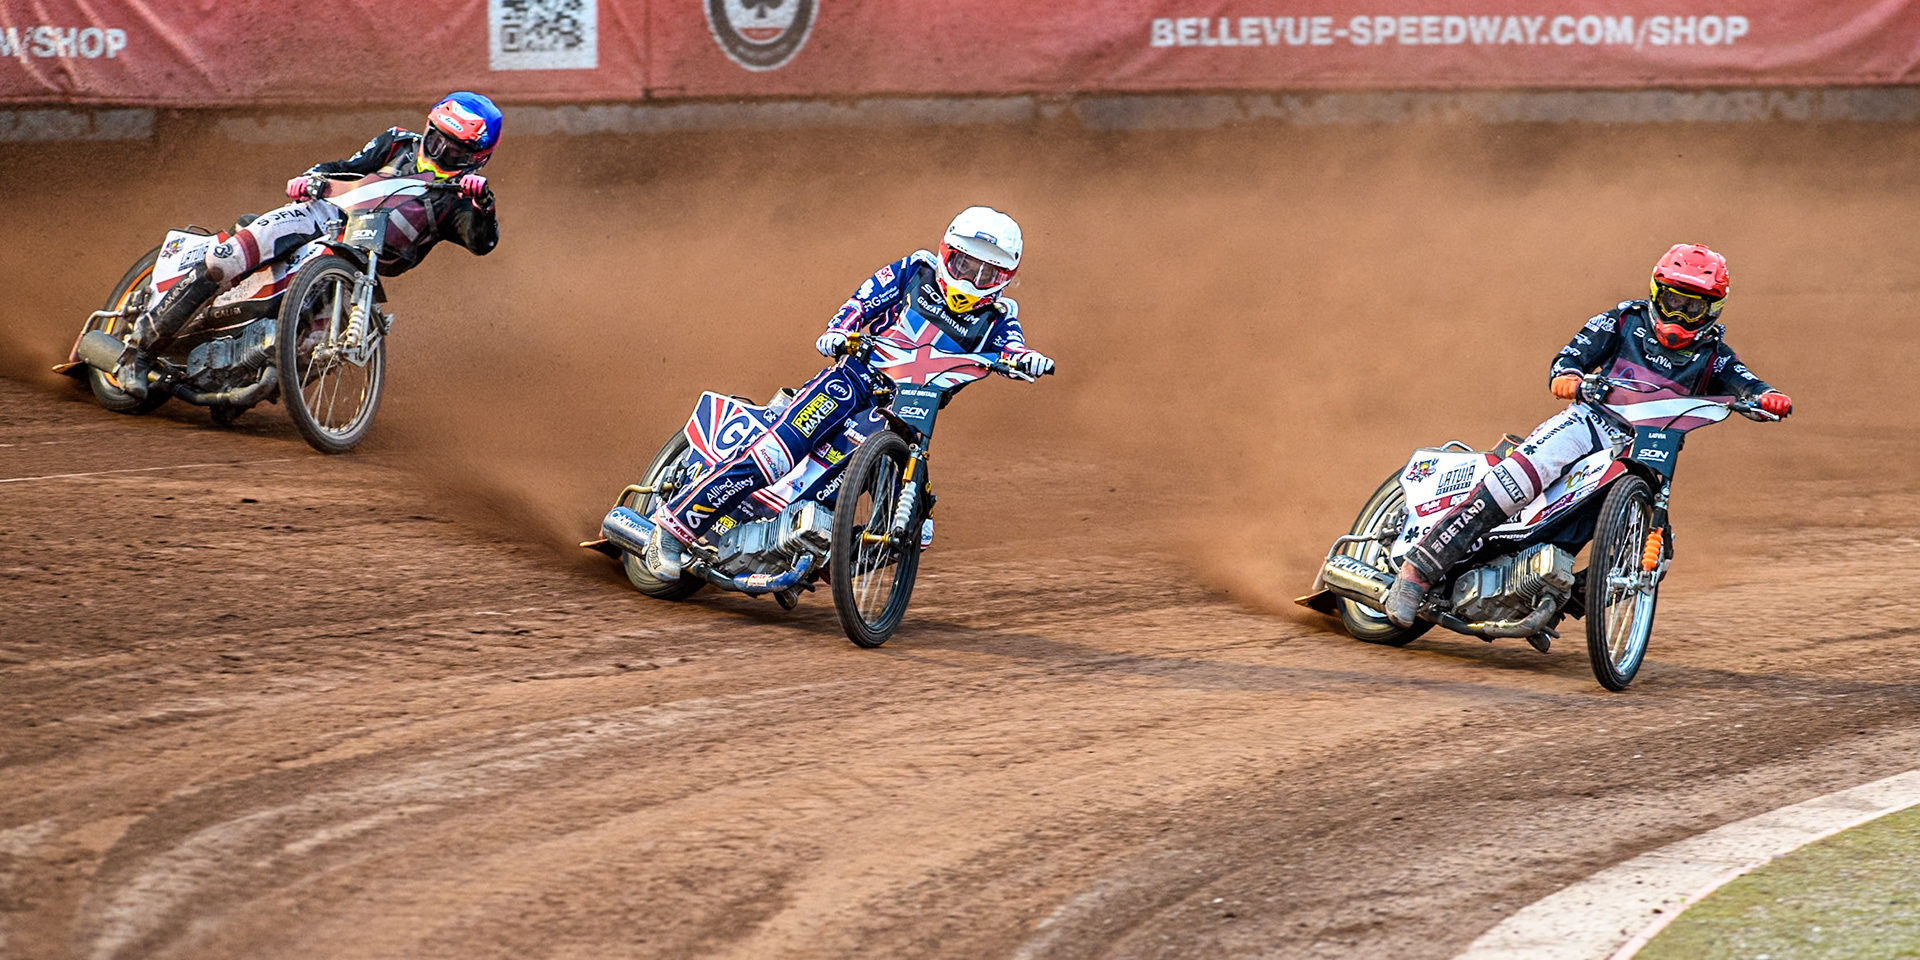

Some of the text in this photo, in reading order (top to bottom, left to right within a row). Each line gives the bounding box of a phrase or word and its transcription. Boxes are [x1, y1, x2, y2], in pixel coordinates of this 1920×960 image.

[1151, 15, 1749, 48] BELLEVUE-SPEEDWAY.COM/SHOP
[917, 296, 969, 337] GREAT BRITAIN
[794, 395, 828, 428] POWER
[801, 399, 835, 435] MAXED
[706, 477, 734, 503] Allied
[711, 475, 755, 509] Mobility
[1438, 464, 1476, 489] LATVIA
[609, 510, 651, 535] Cabinmaste
[1439, 498, 1486, 545] BETARD
